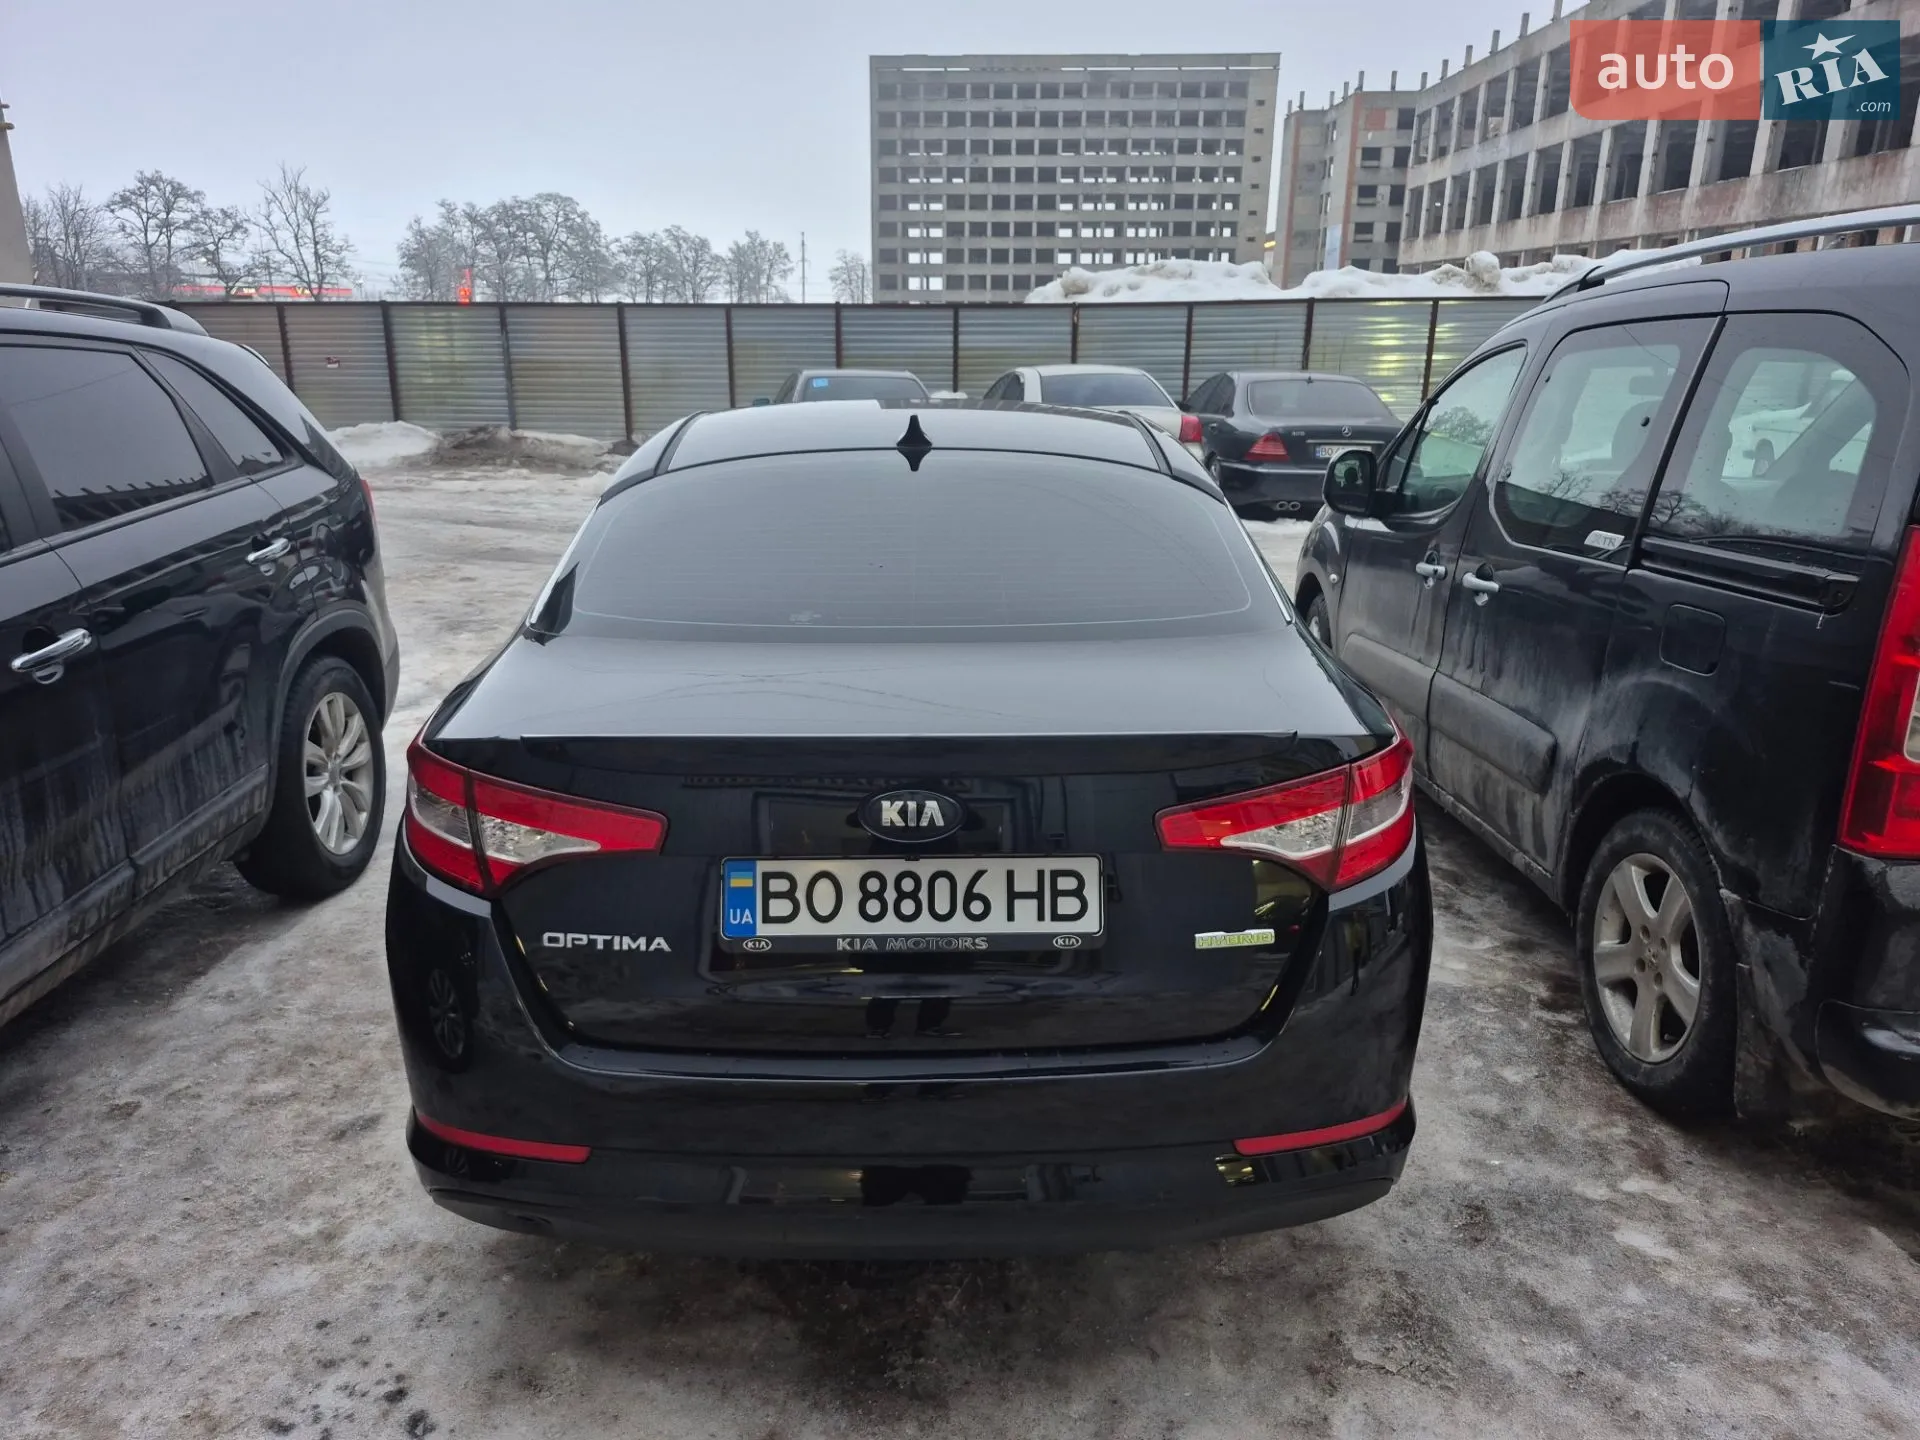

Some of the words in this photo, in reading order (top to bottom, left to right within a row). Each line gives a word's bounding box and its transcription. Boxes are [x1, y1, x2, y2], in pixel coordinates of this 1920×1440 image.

[881, 800, 945, 827] KIA
[761, 869, 843, 924] BO
[858, 869, 992, 923] 8806
[1007, 869, 1089, 923] HB
[730, 908, 753, 926] UA
[542, 931, 672, 952] OPTIMA
[836, 937, 878, 951] KIA
[886, 937, 989, 951] MOTORS
[1199, 931, 1273, 947] HYBRID
